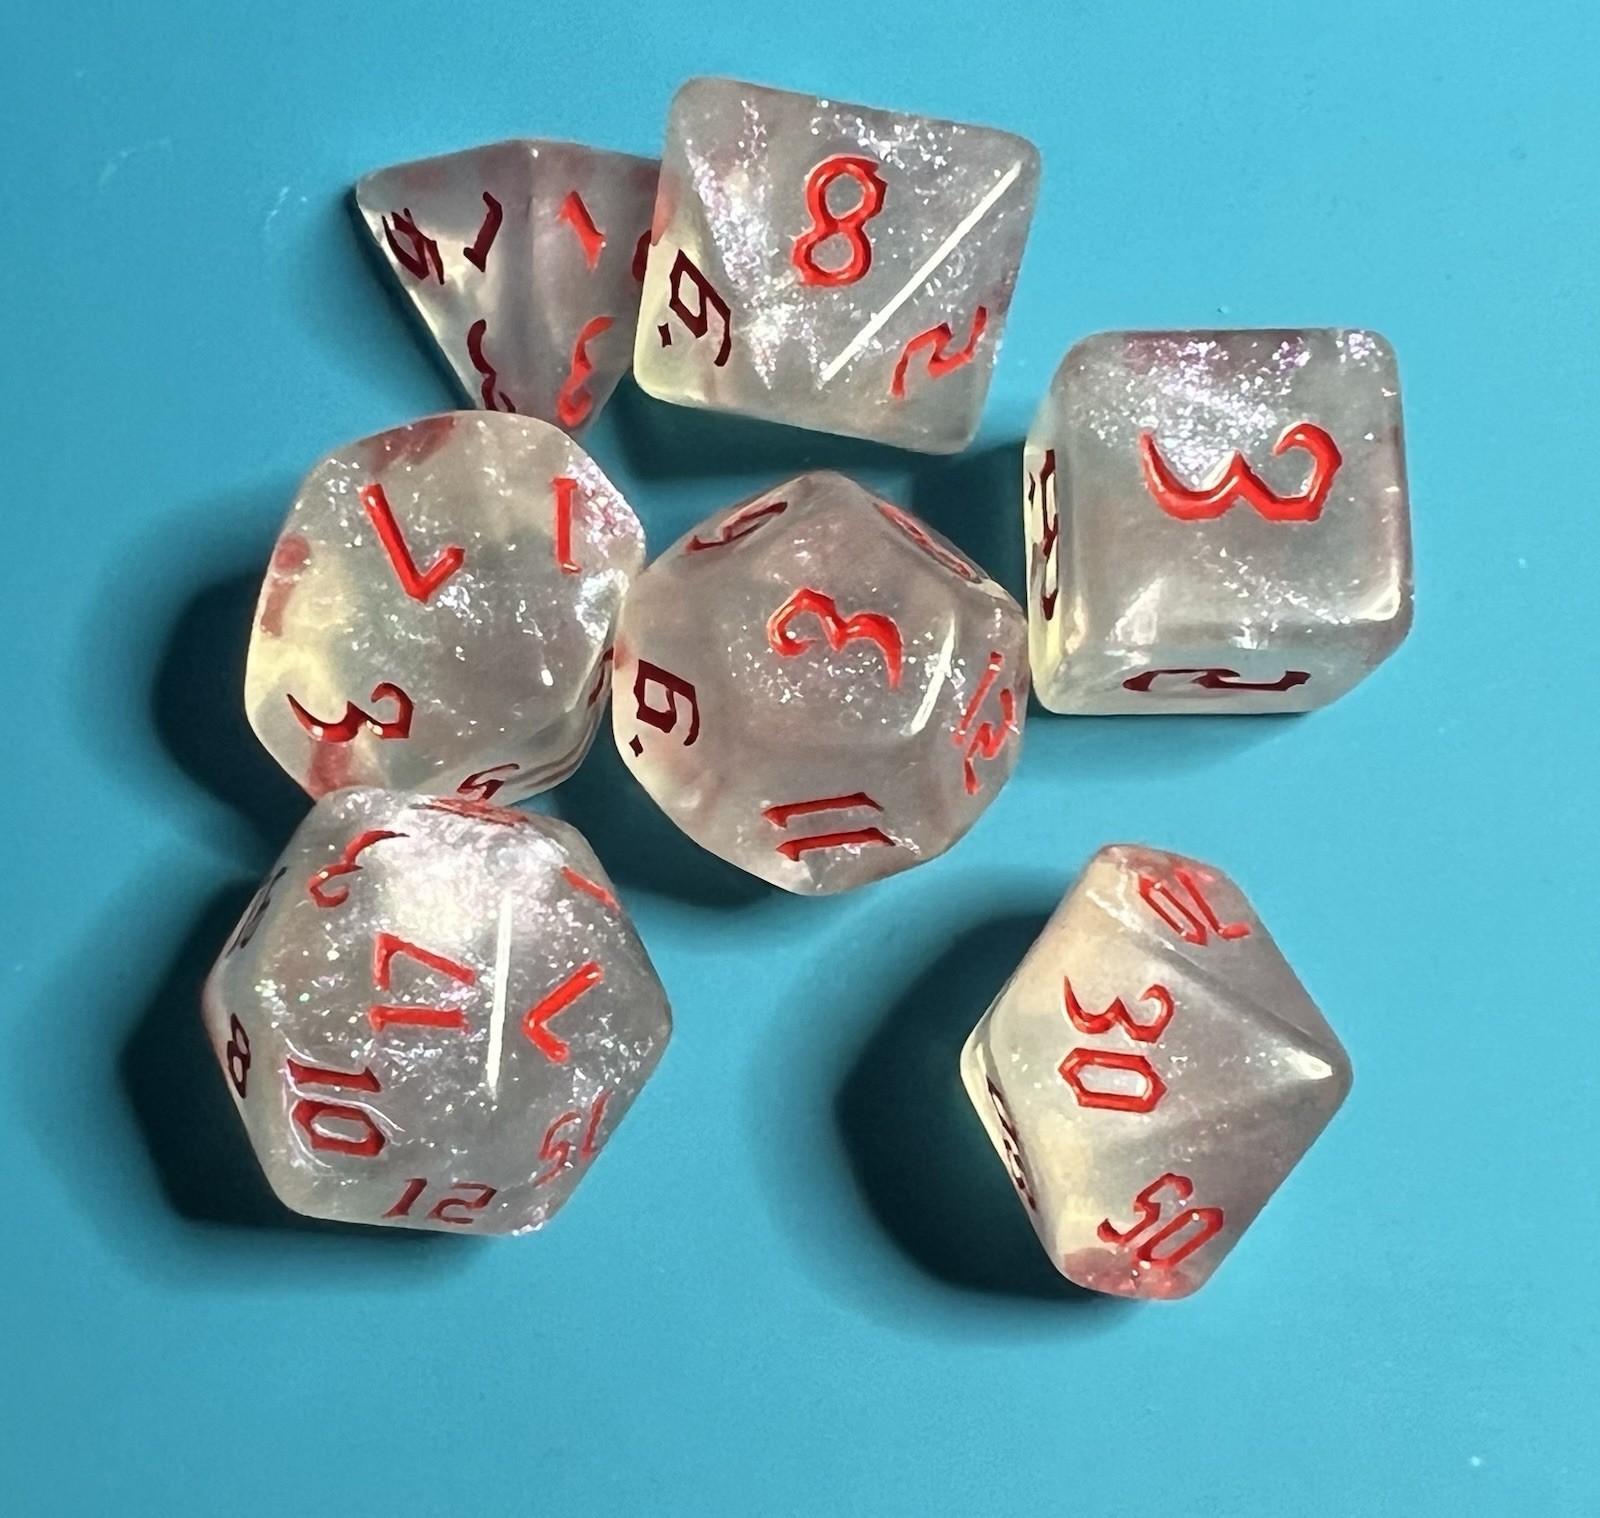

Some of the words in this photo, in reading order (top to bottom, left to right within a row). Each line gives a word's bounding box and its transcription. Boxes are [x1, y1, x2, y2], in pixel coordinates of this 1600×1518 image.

[793, 153, 888, 289] 8
[890, 304, 989, 401] 2
[1137, 421, 1343, 524] 3
[360, 483, 466, 605] 7
[551, 475, 583, 575] 1
[765, 586, 906, 692] 3
[286, 681, 415, 743] 3
[307, 829, 410, 909] 3
[761, 790, 897, 862] 11
[1135, 862, 1252, 947] 70
[366, 931, 478, 1035] 17
[522, 960, 604, 1065] 7
[226, 1012, 252, 1100] 8
[1056, 974, 1177, 1114] 30
[284, 1053, 388, 1159] 10
[382, 1177, 499, 1226] 12
[1096, 1171, 1226, 1268] 50
